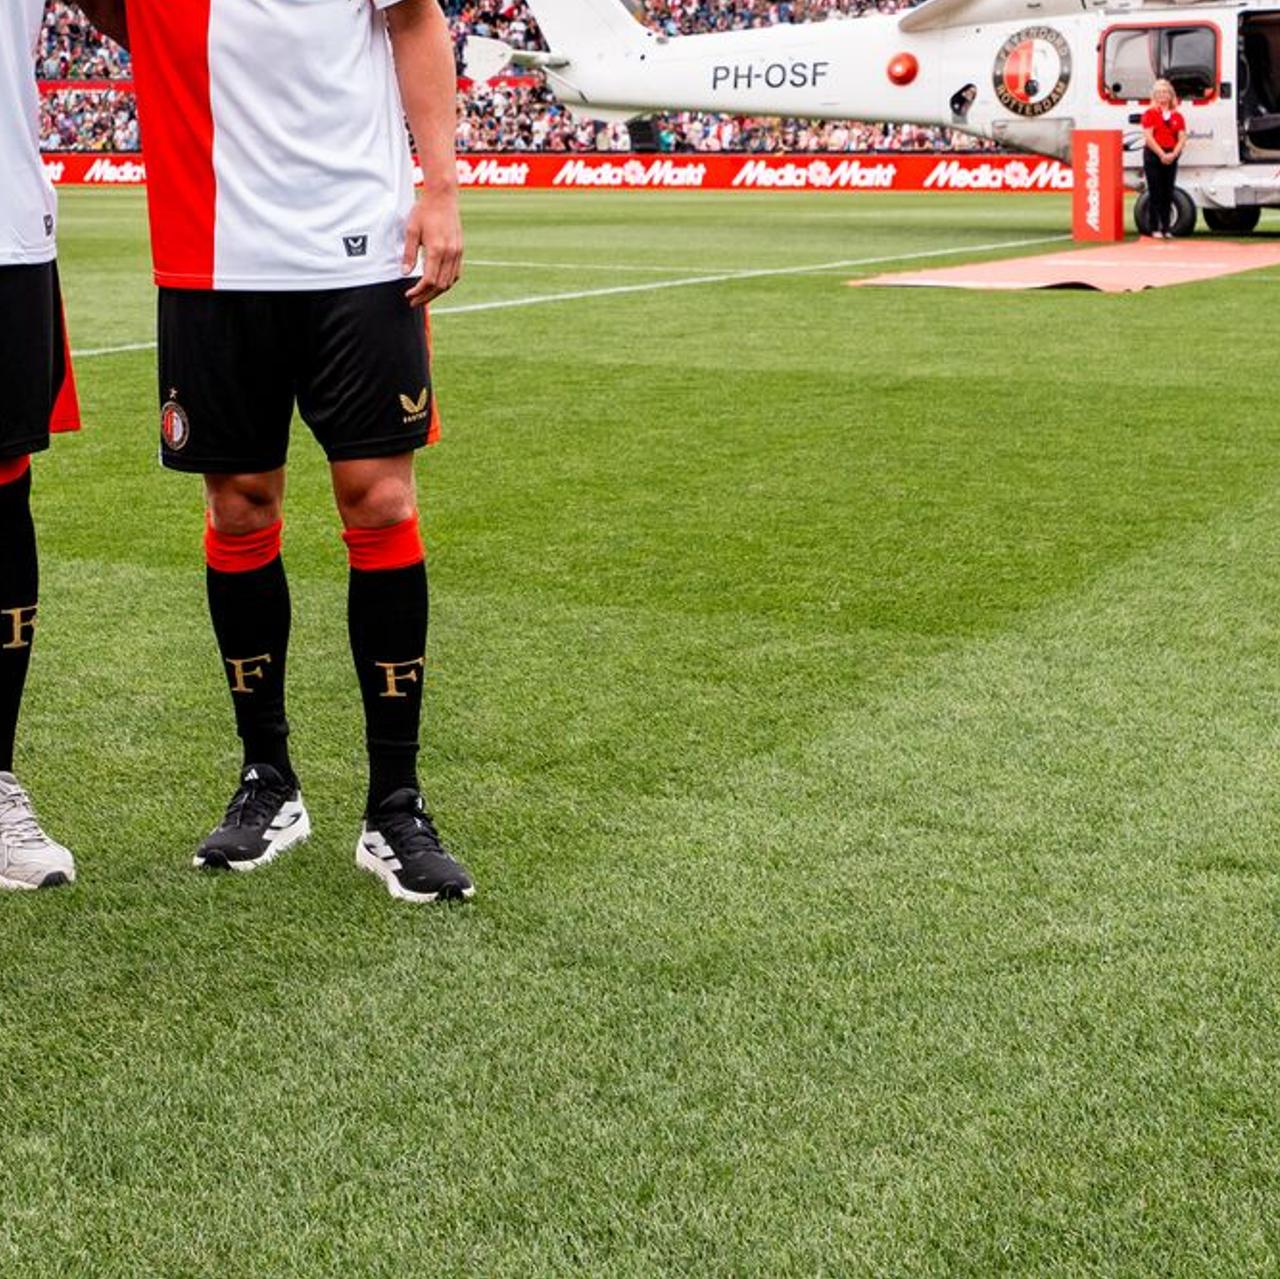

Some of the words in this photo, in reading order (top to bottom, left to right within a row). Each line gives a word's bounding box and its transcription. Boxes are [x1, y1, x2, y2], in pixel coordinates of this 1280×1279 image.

[712, 61, 830, 92] PH-OSF
[471, 159, 530, 184] Markt
[553, 160, 621, 186] Media
[637, 160, 707, 186] Markt
[732, 161, 810, 187] Media
[824, 161, 897, 188] Markt
[924, 160, 1004, 189] Media
[225, 652, 272, 694] F
[375, 656, 425, 699] F
